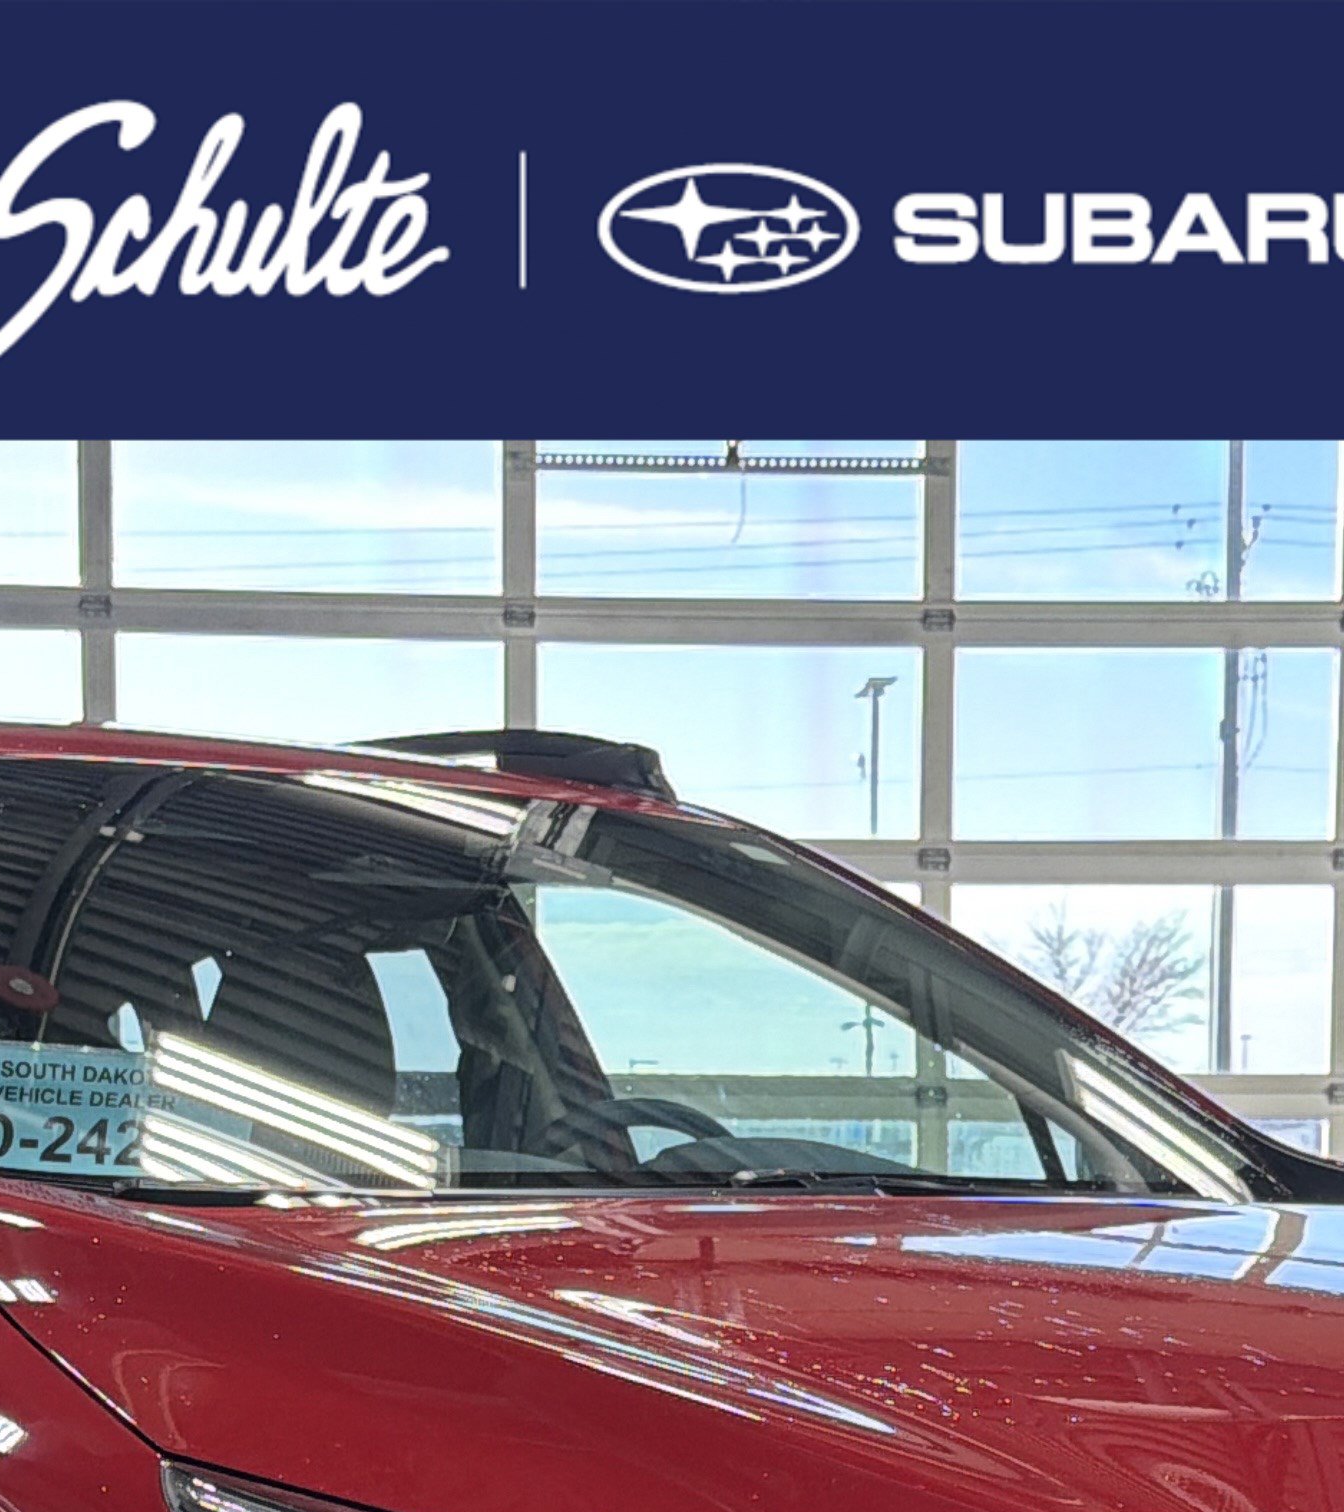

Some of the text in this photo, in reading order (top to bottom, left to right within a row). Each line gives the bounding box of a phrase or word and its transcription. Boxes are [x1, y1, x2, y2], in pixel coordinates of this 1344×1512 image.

[0, 1060, 153, 1086] SOUTH DAKO
[89, 1091, 176, 1111] DEALER
